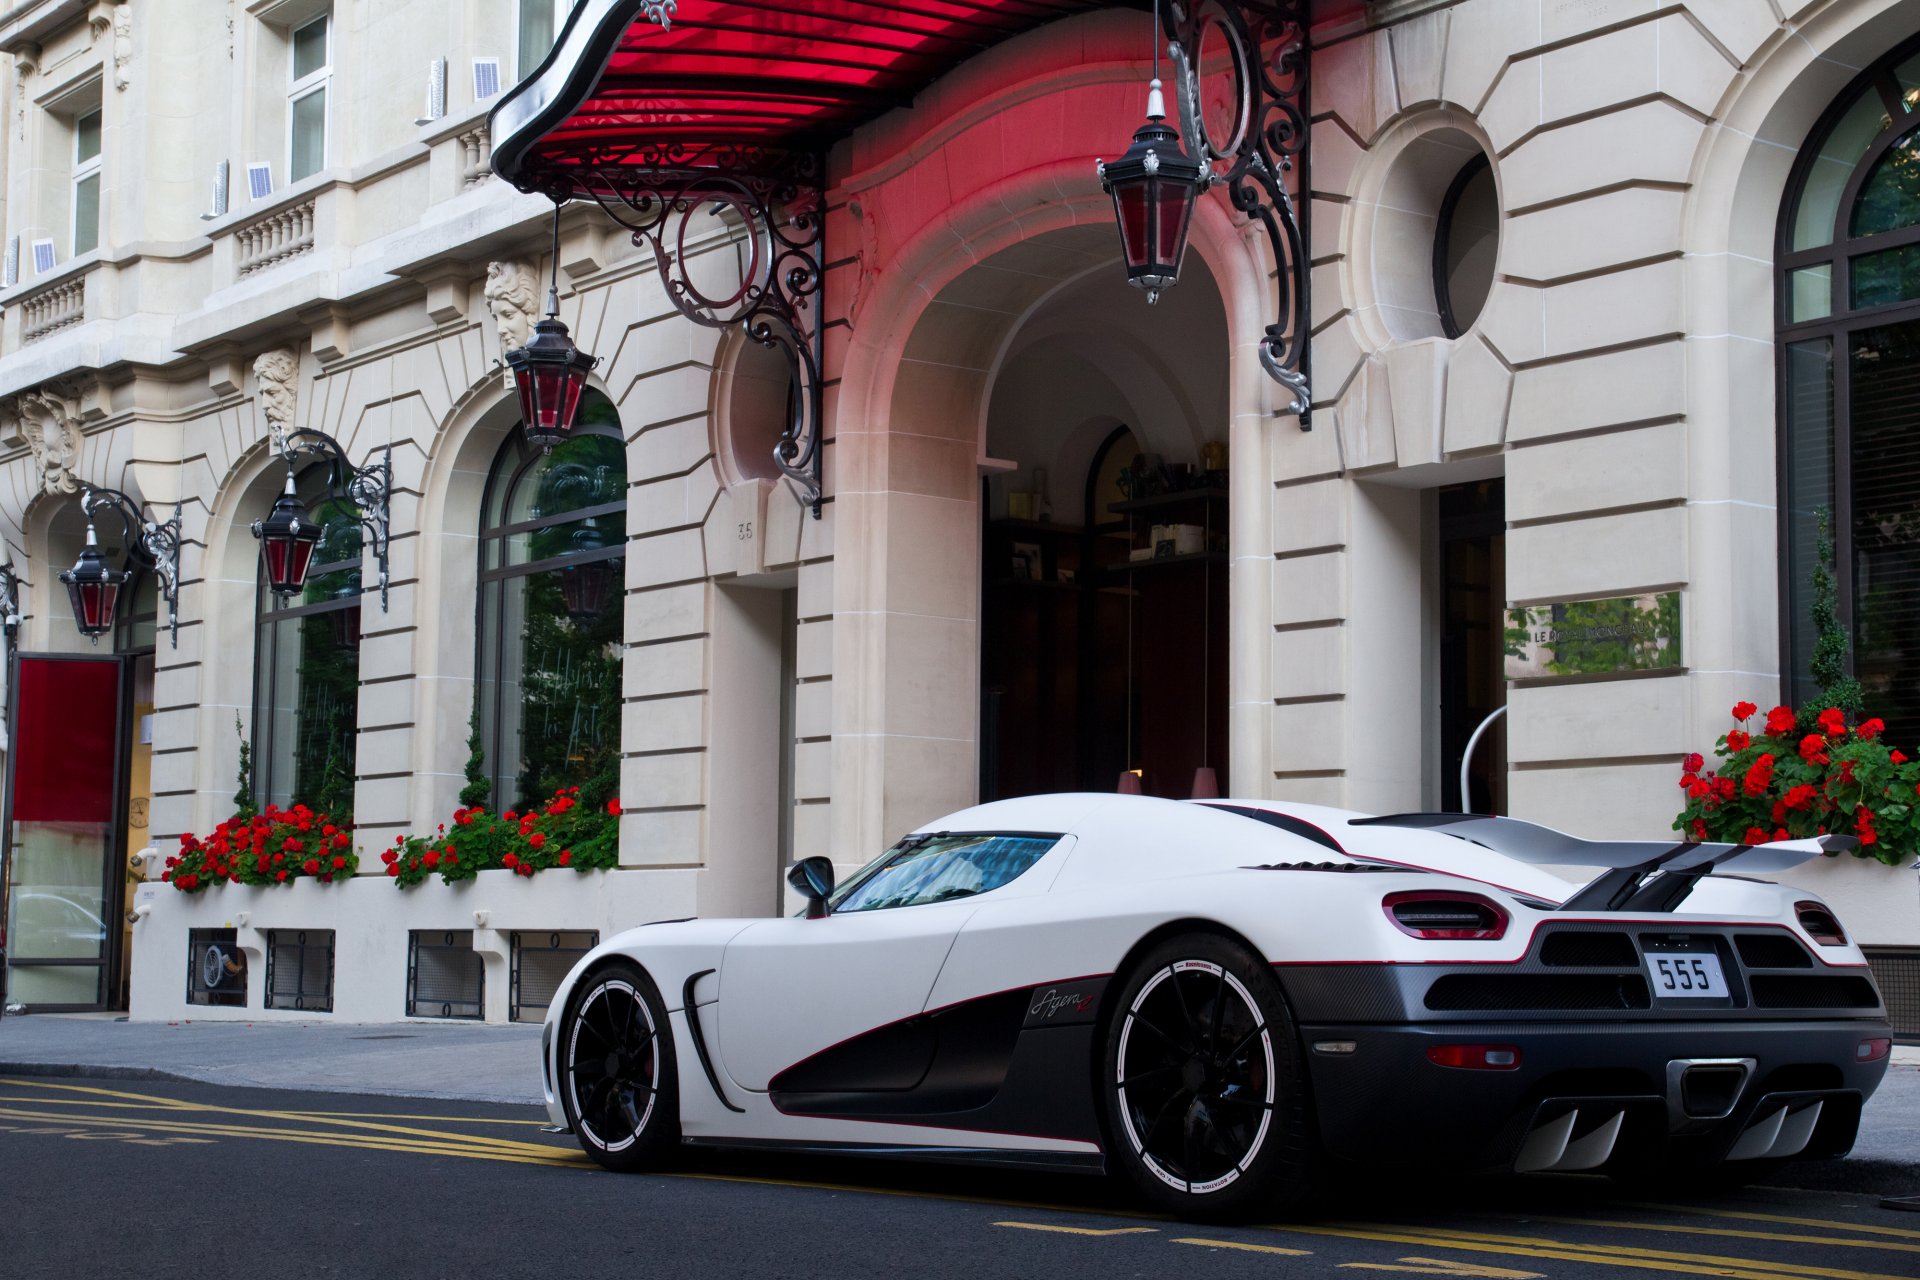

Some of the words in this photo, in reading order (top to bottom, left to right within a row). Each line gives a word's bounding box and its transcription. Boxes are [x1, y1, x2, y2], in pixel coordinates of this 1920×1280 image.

[738, 522, 752, 540] 35
[1535, 631, 1546, 643] LE
[1656, 959, 1710, 990] 555
[1031, 989, 1081, 1020] Agera
[1202, 1178, 1228, 1190] ROTATION
